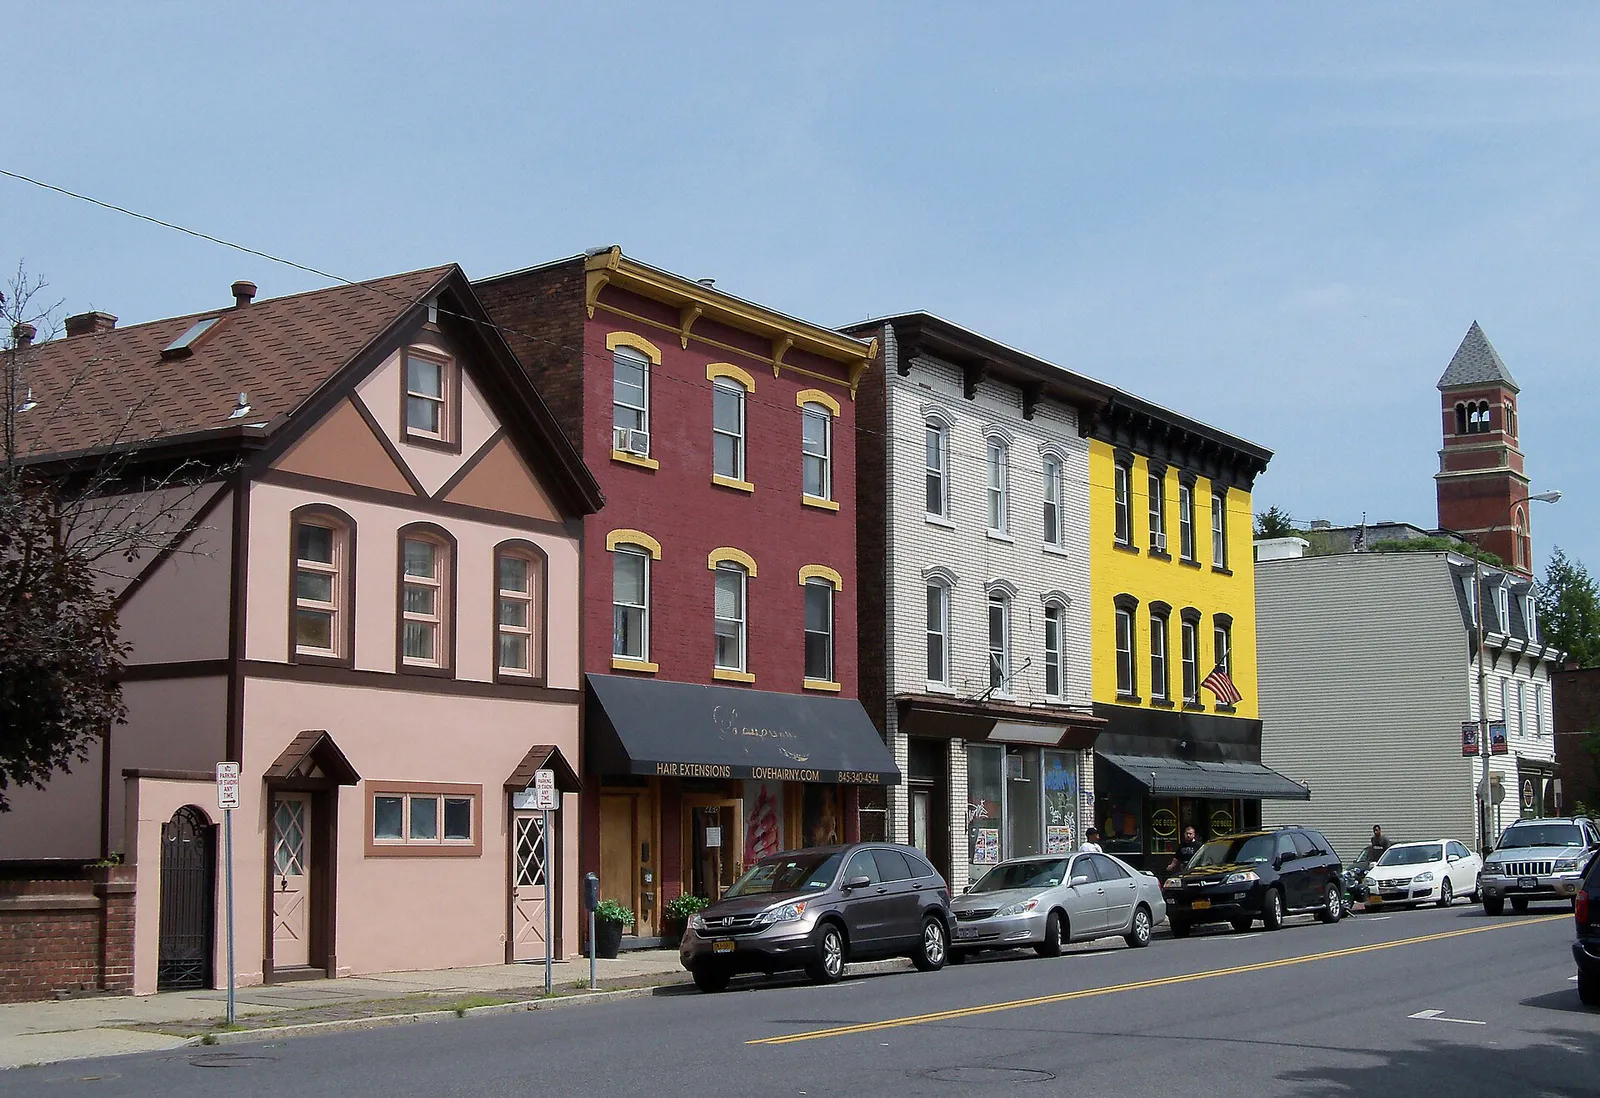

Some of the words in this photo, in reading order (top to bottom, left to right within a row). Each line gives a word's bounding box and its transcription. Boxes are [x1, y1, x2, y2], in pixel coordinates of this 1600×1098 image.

[656, 762, 677, 775] HAIR
[680, 763, 731, 777] EXTENSIONS
[752, 767, 819, 780] LOVEHAIRNY.COM
[838, 771, 879, 783] 845-340-4544
